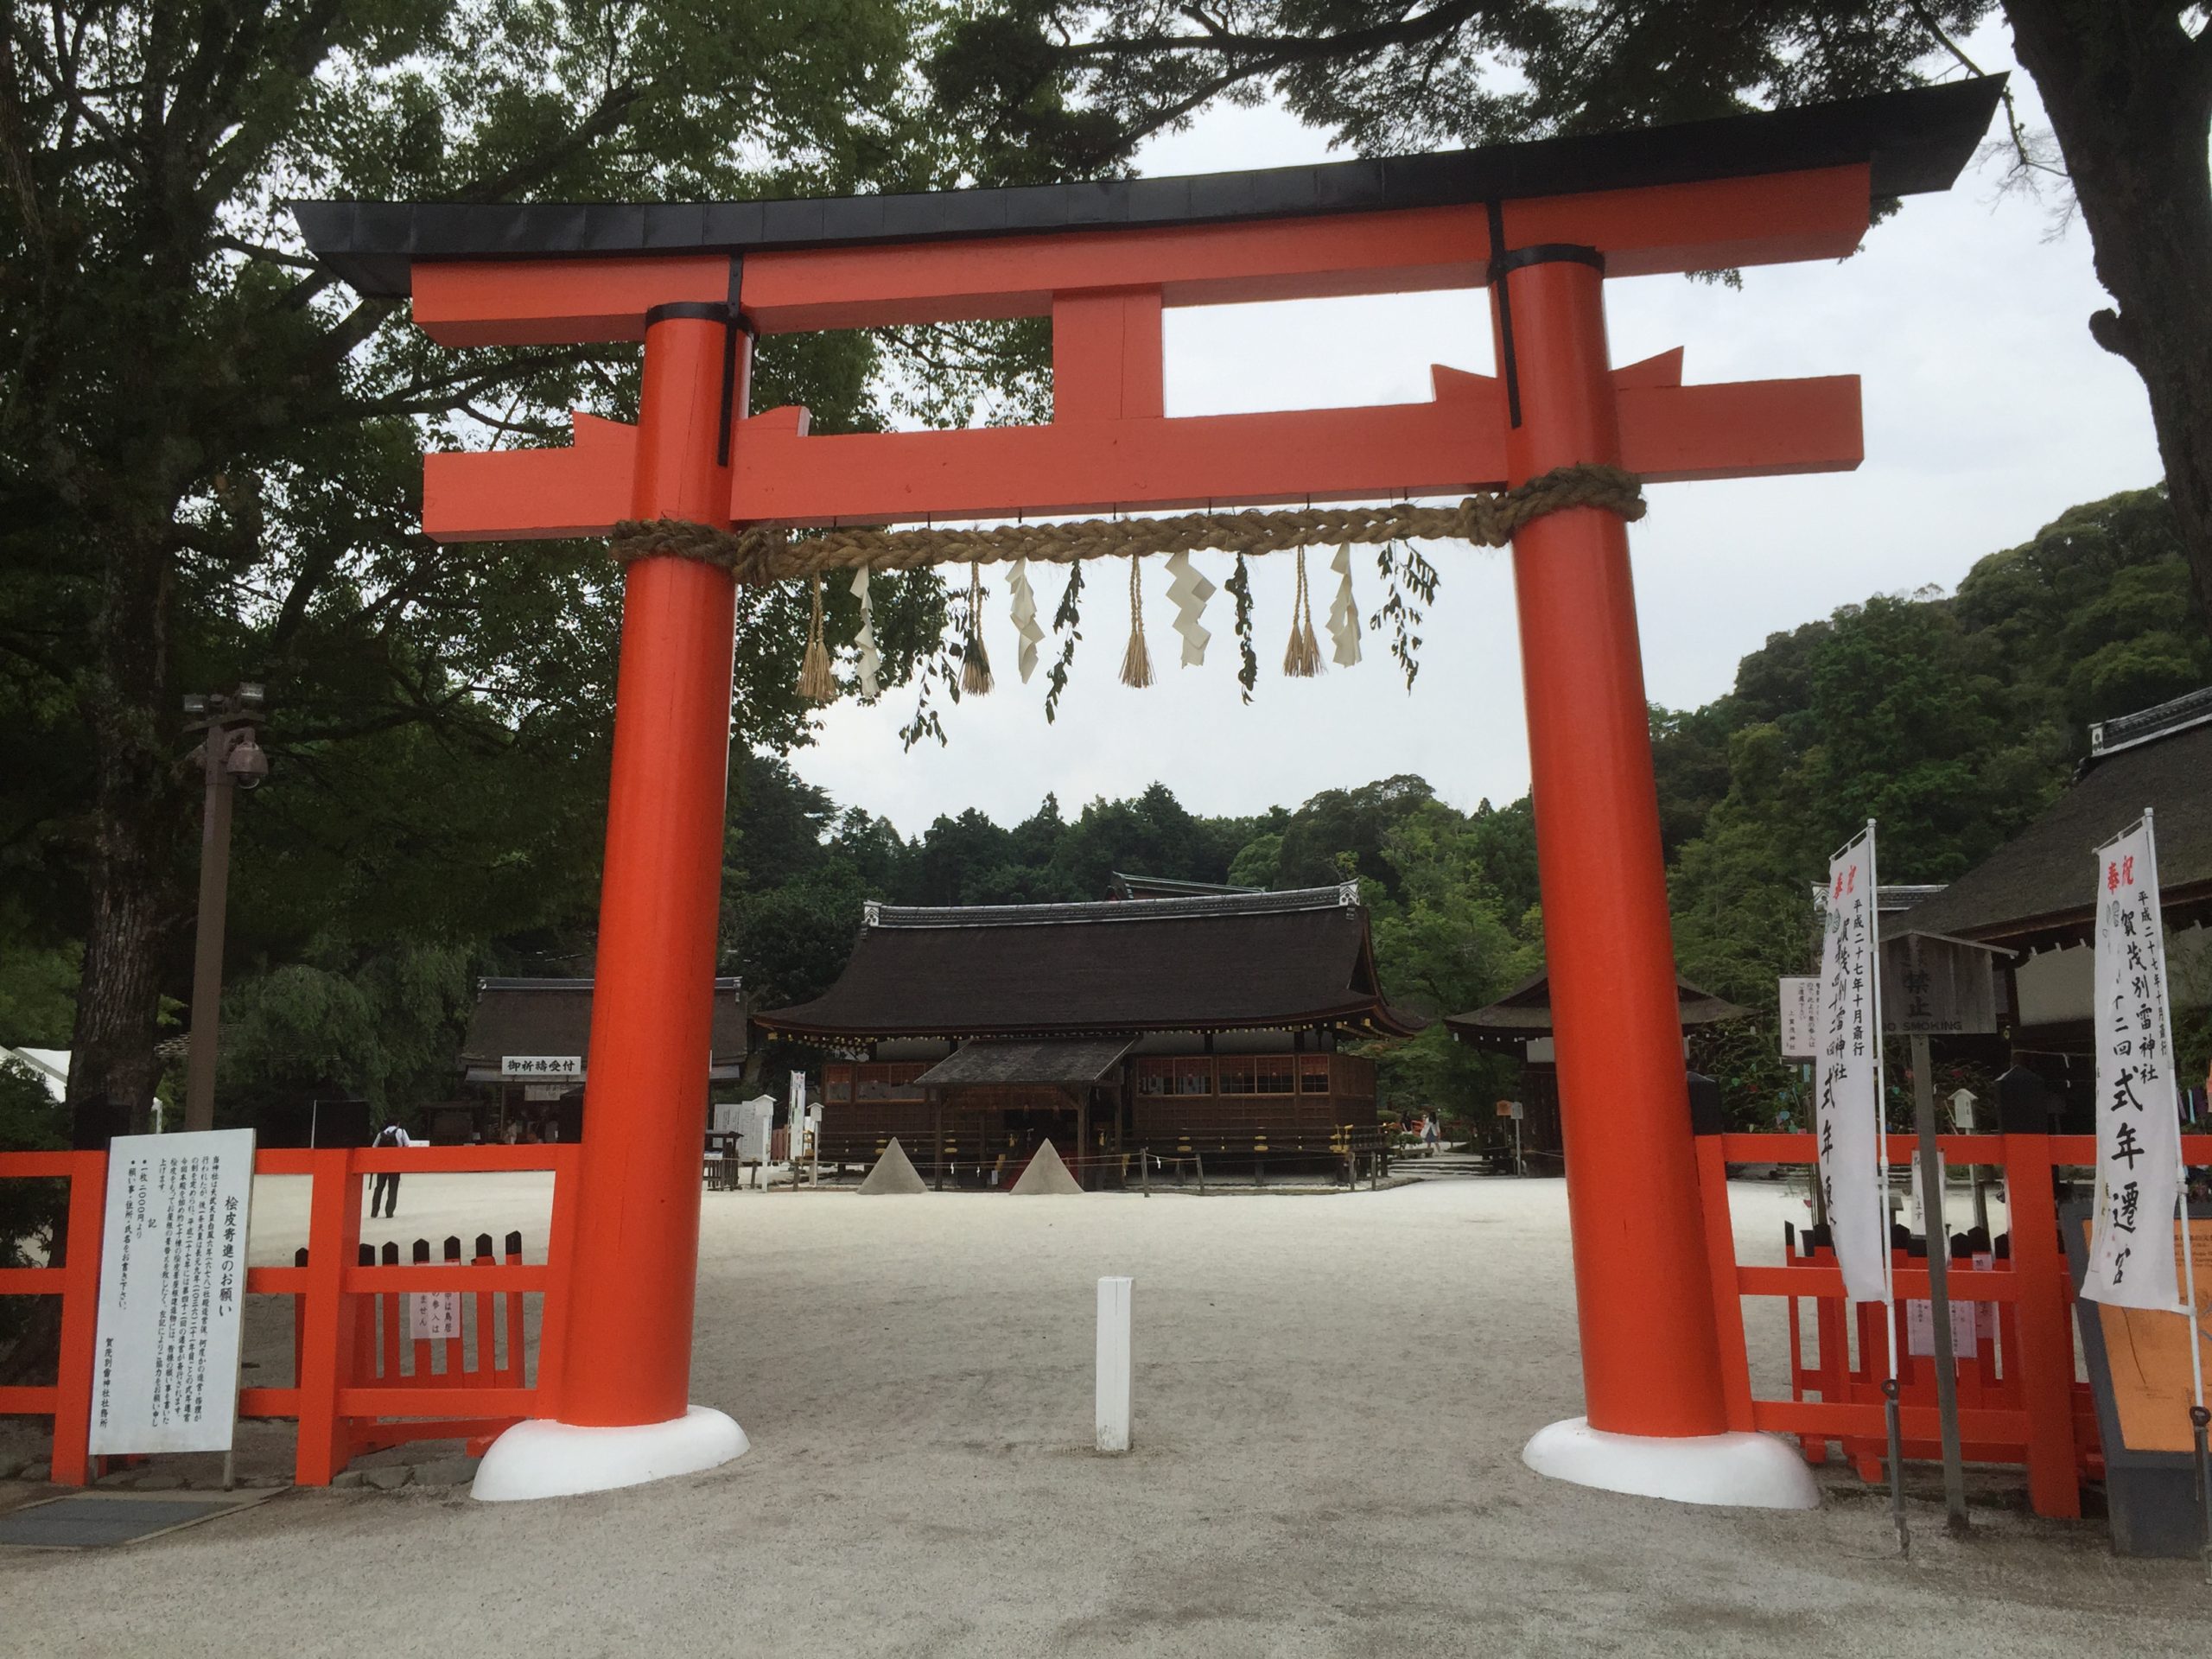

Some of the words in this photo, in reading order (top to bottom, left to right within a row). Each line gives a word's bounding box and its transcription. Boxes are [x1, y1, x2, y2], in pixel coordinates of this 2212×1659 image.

[1903, 1020, 1963, 1032] SMOKING
[2121, 909, 2158, 1084] 賀茂別雷神社
[147, 1217, 157, 1229] 記
[219, 1195, 238, 1317] 桧皮寄進のお願い
